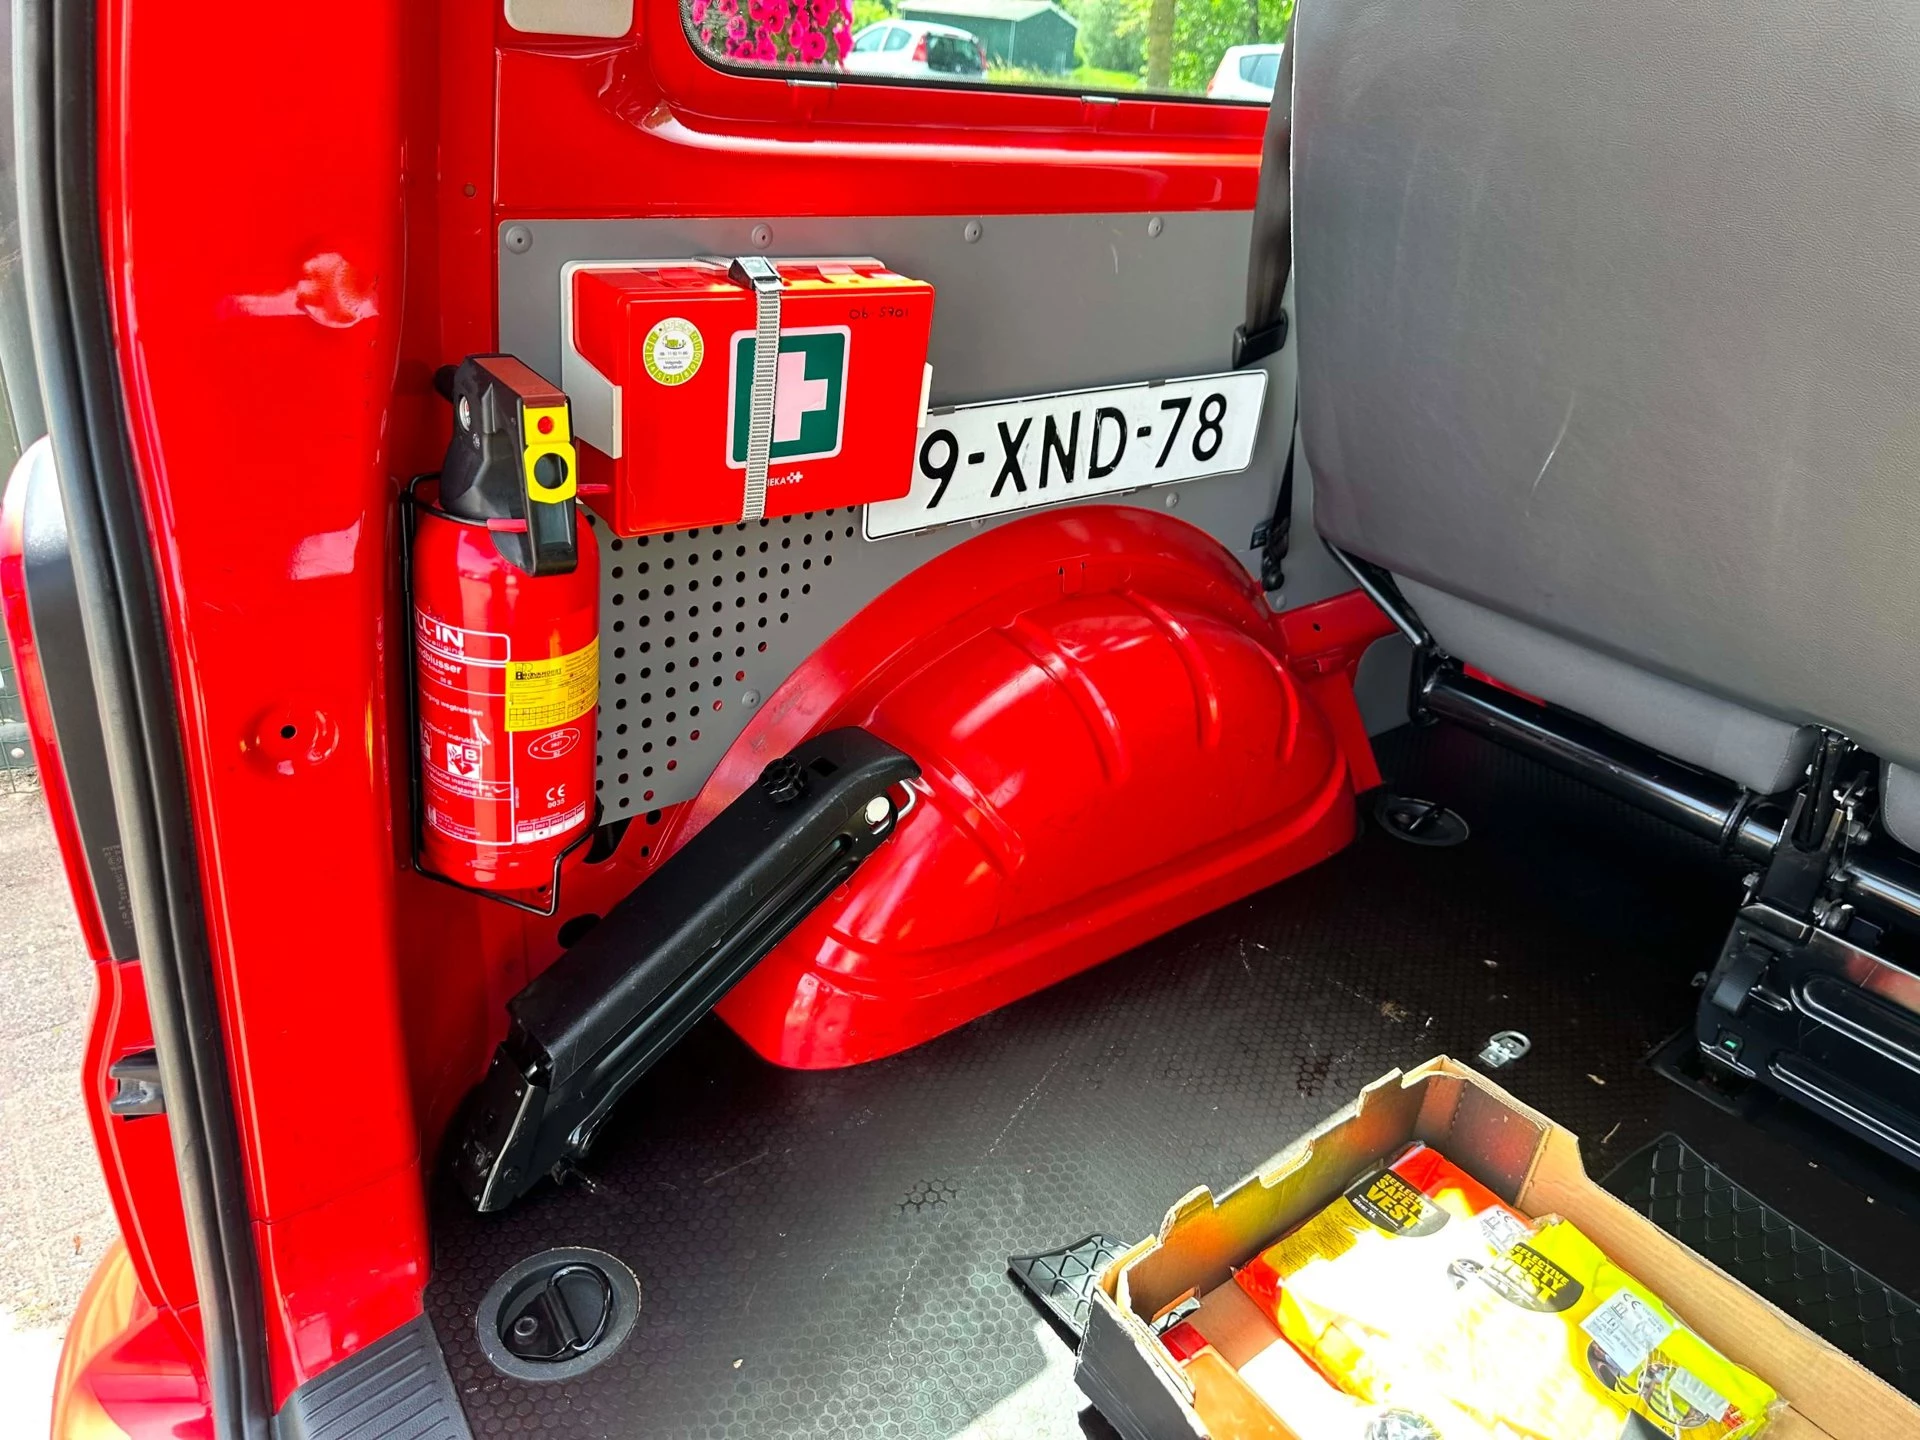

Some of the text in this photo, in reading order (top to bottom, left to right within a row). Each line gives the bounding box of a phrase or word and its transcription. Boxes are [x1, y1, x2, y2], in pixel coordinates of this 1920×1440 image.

[918, 393, 1228, 510] 9-XND-78
[416, 611, 464, 649] LL-IN
[464, 748, 478, 761] B
[1366, 1184, 1423, 1229] VEST
[1376, 1178, 1427, 1217] SAFET
[1513, 1245, 1570, 1286] EFLECTIVE
